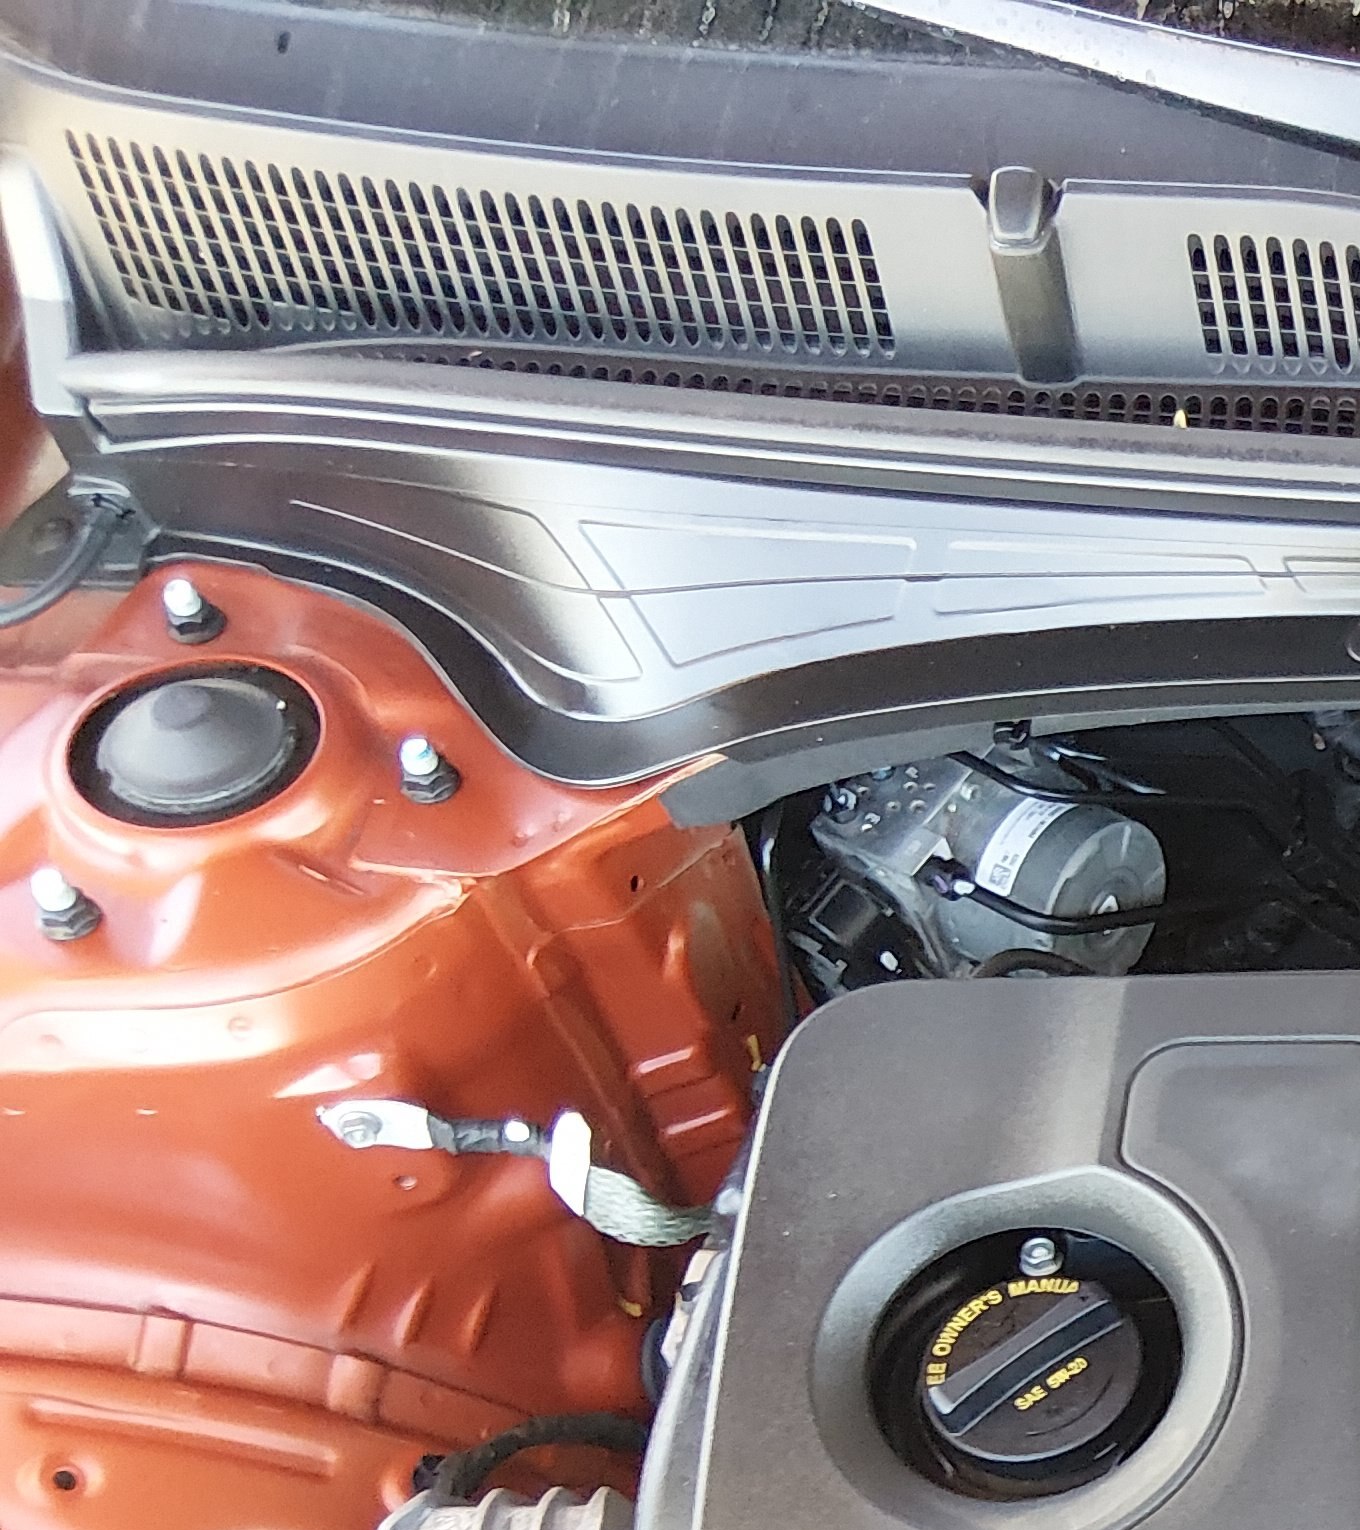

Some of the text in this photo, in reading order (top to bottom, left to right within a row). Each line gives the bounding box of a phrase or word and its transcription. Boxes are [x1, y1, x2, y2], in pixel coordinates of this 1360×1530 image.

[925, 1278, 1080, 1386] EE OWNER'S MANUA
[1014, 1385, 1048, 1410] SAE
